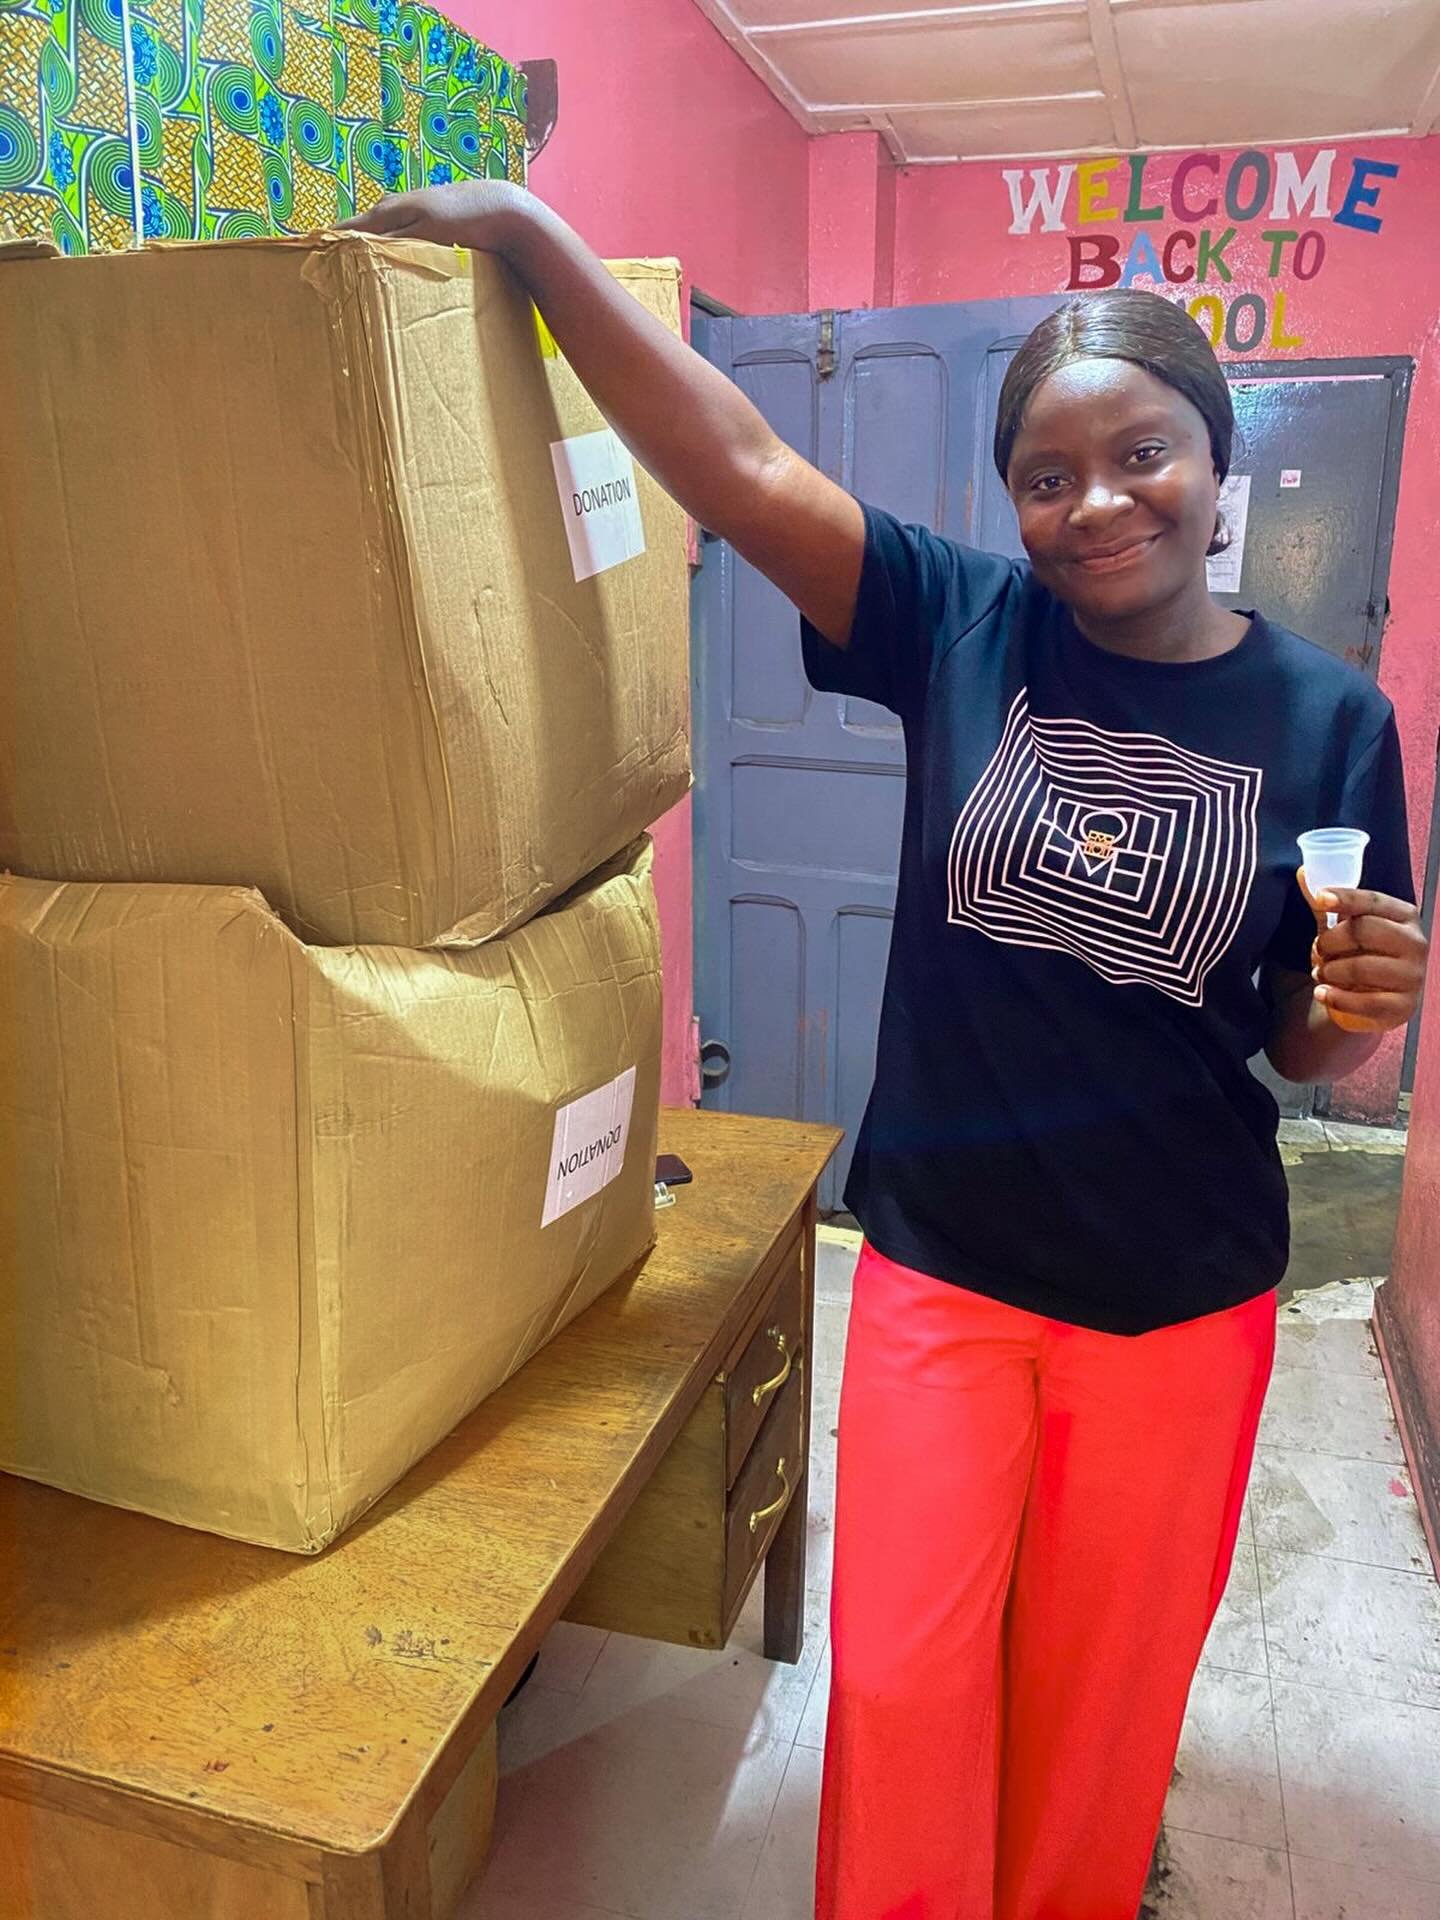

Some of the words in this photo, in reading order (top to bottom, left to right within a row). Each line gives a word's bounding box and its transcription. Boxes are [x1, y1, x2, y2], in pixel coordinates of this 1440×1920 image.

[1002, 150, 1400, 234] WELCOME
[1066, 227, 1237, 291] BACK
[1261, 230, 1325, 281] TO
[1177, 289, 1304, 352] OOL
[572, 477, 631, 516] DONATION
[557, 1124, 622, 1181] DONATION
